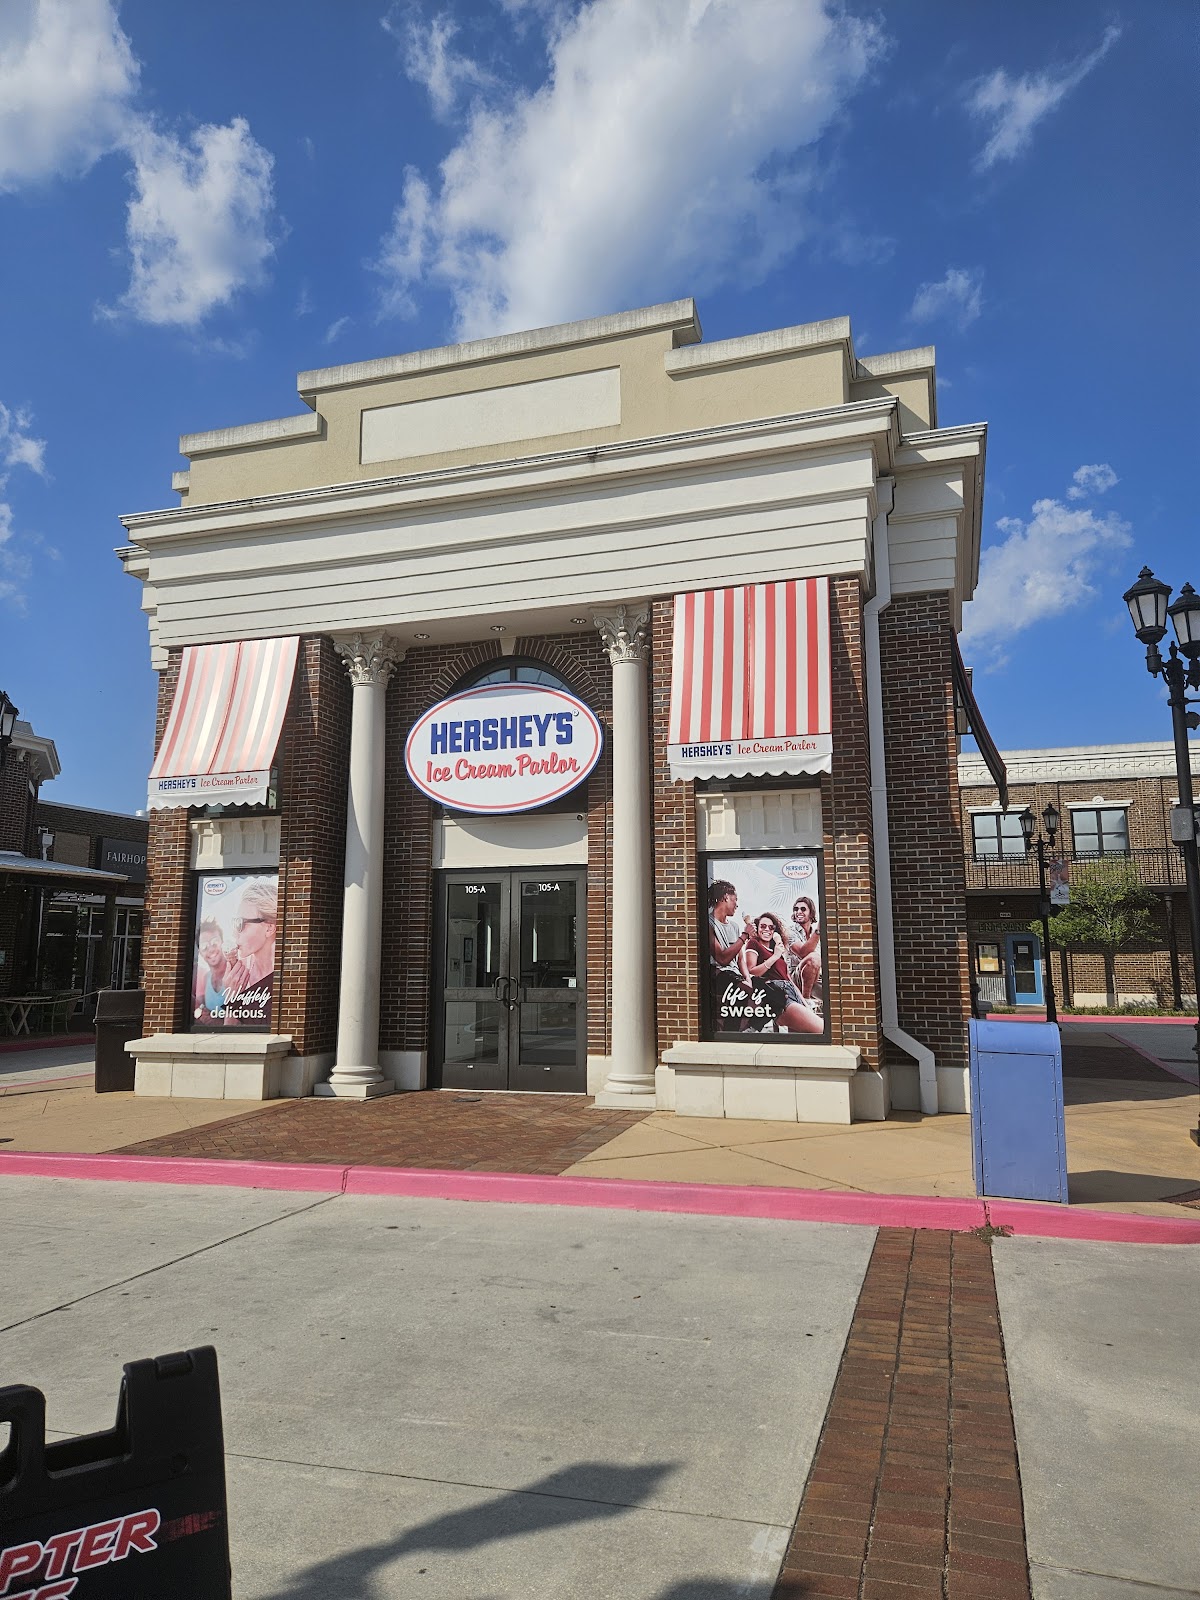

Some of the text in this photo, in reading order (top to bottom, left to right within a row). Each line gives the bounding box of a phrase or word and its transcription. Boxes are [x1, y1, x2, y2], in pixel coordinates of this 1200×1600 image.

[738, 743, 751, 755] Ice
[753, 742, 784, 754] Cream
[784, 739, 817, 751] Parlor
[426, 752, 580, 783] Ice Cream Parlor
[200, 778, 211, 788] Ice
[211, 777, 235, 787] Cream
[235, 775, 258, 785] Parlor
[107, 851, 146, 865] FAIRHOP
[465, 885, 486, 894] 105-A
[538, 883, 560, 892] 105-A
[979, 921, 1031, 933] ENTRANC
[722, 982, 767, 1006] life is
[210, 1005, 267, 1019] delicious.
[720, 1003, 777, 1018] sweet.
[0, 1508, 161, 1595] PTER
